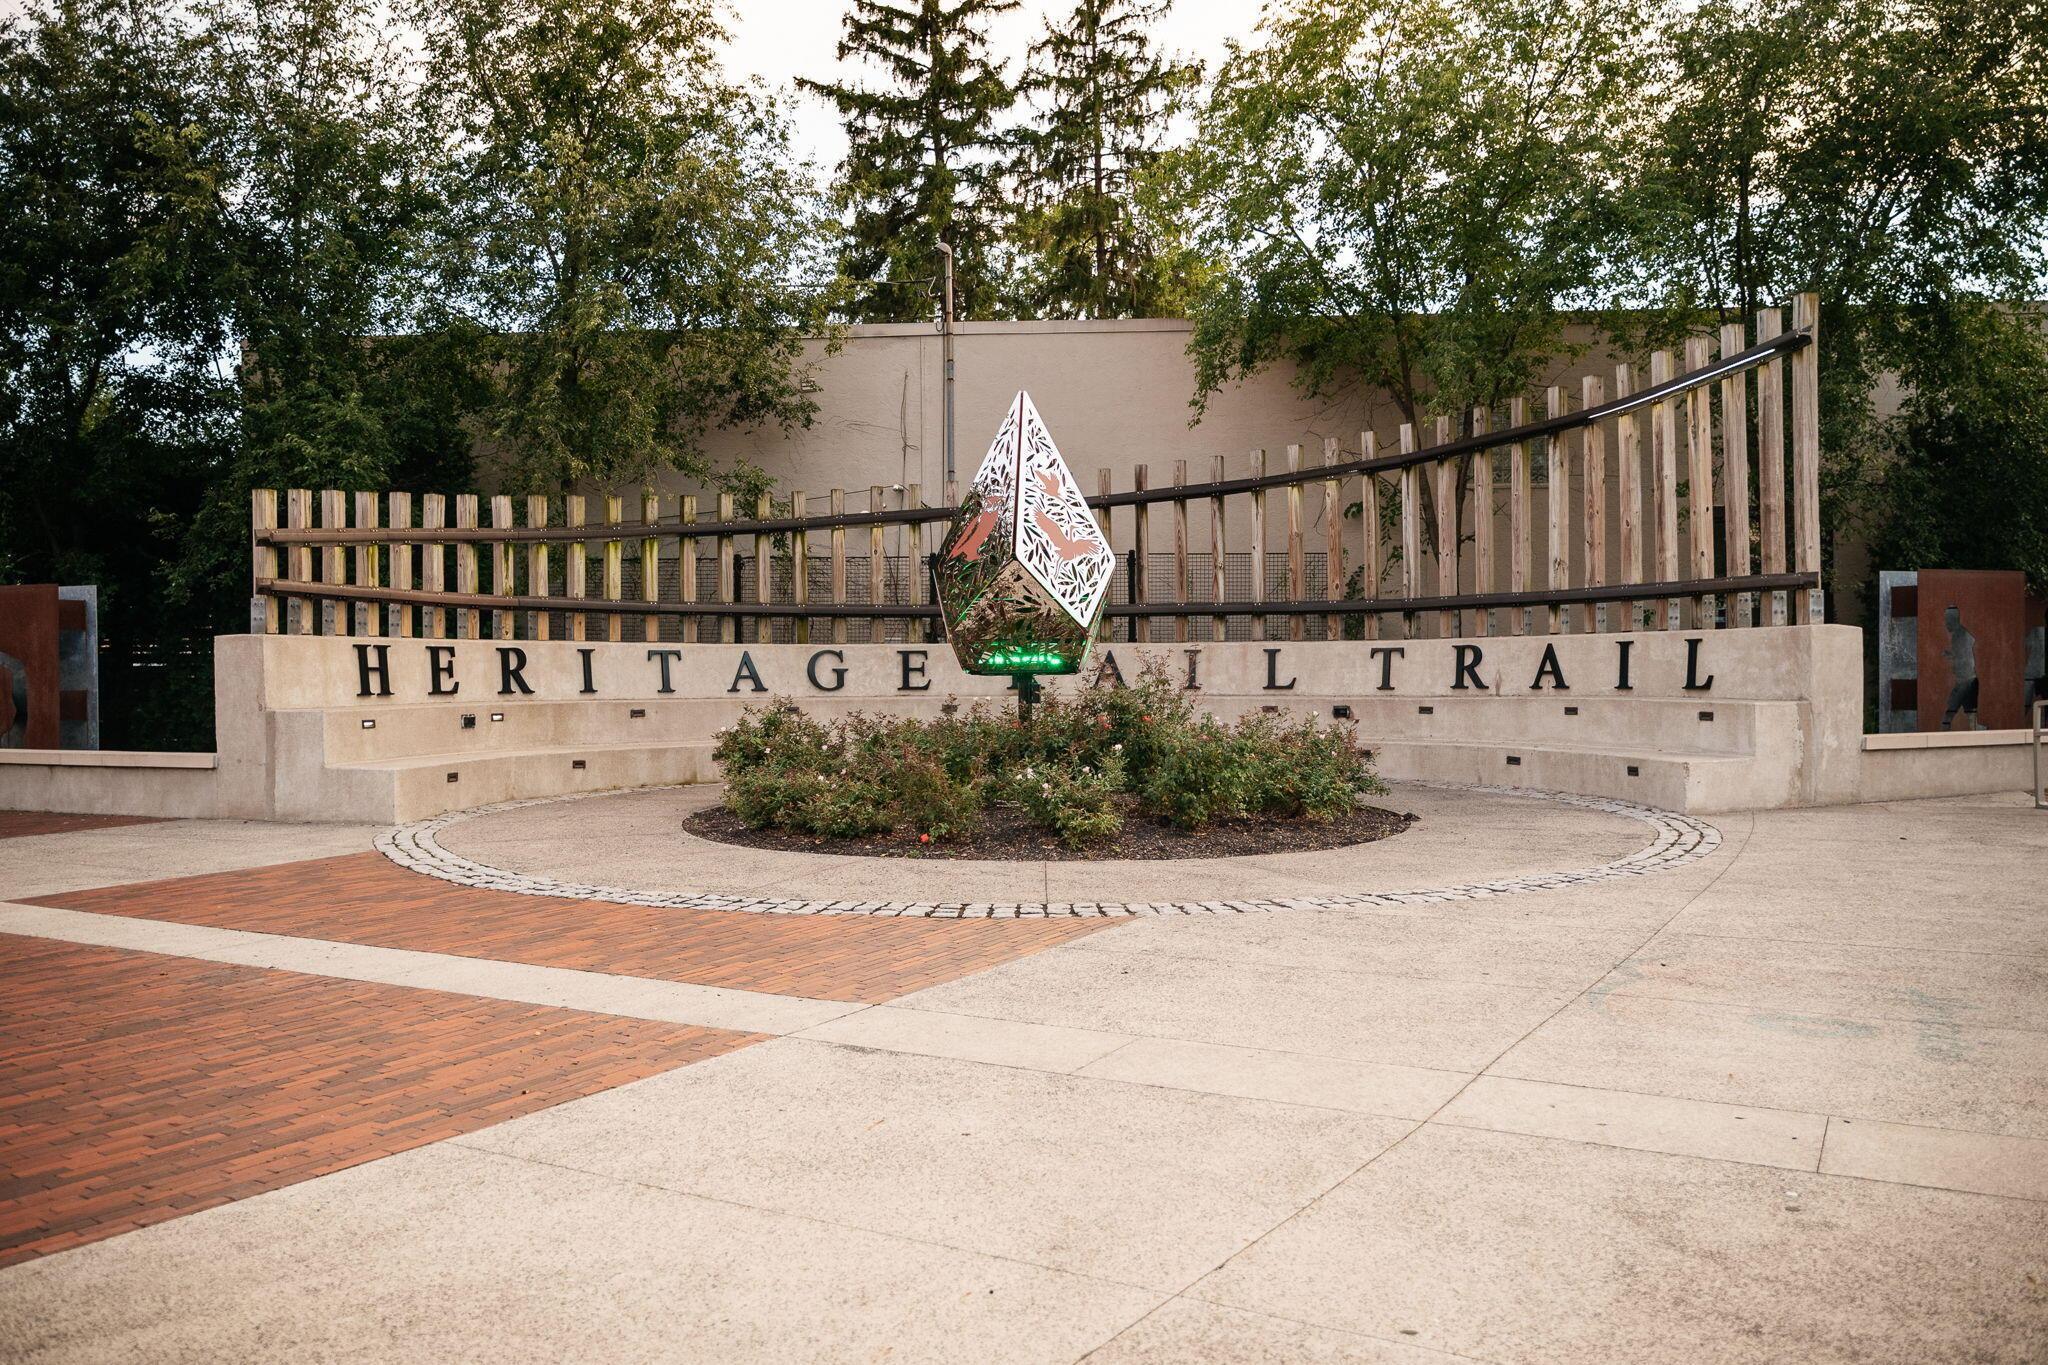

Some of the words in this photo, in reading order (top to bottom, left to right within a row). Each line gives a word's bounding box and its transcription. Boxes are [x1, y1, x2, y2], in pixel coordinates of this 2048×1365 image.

[353, 643, 933, 697] HERITAGE
[1006, 648, 1297, 691] AIL
[1370, 638, 1714, 691] TRAIL
